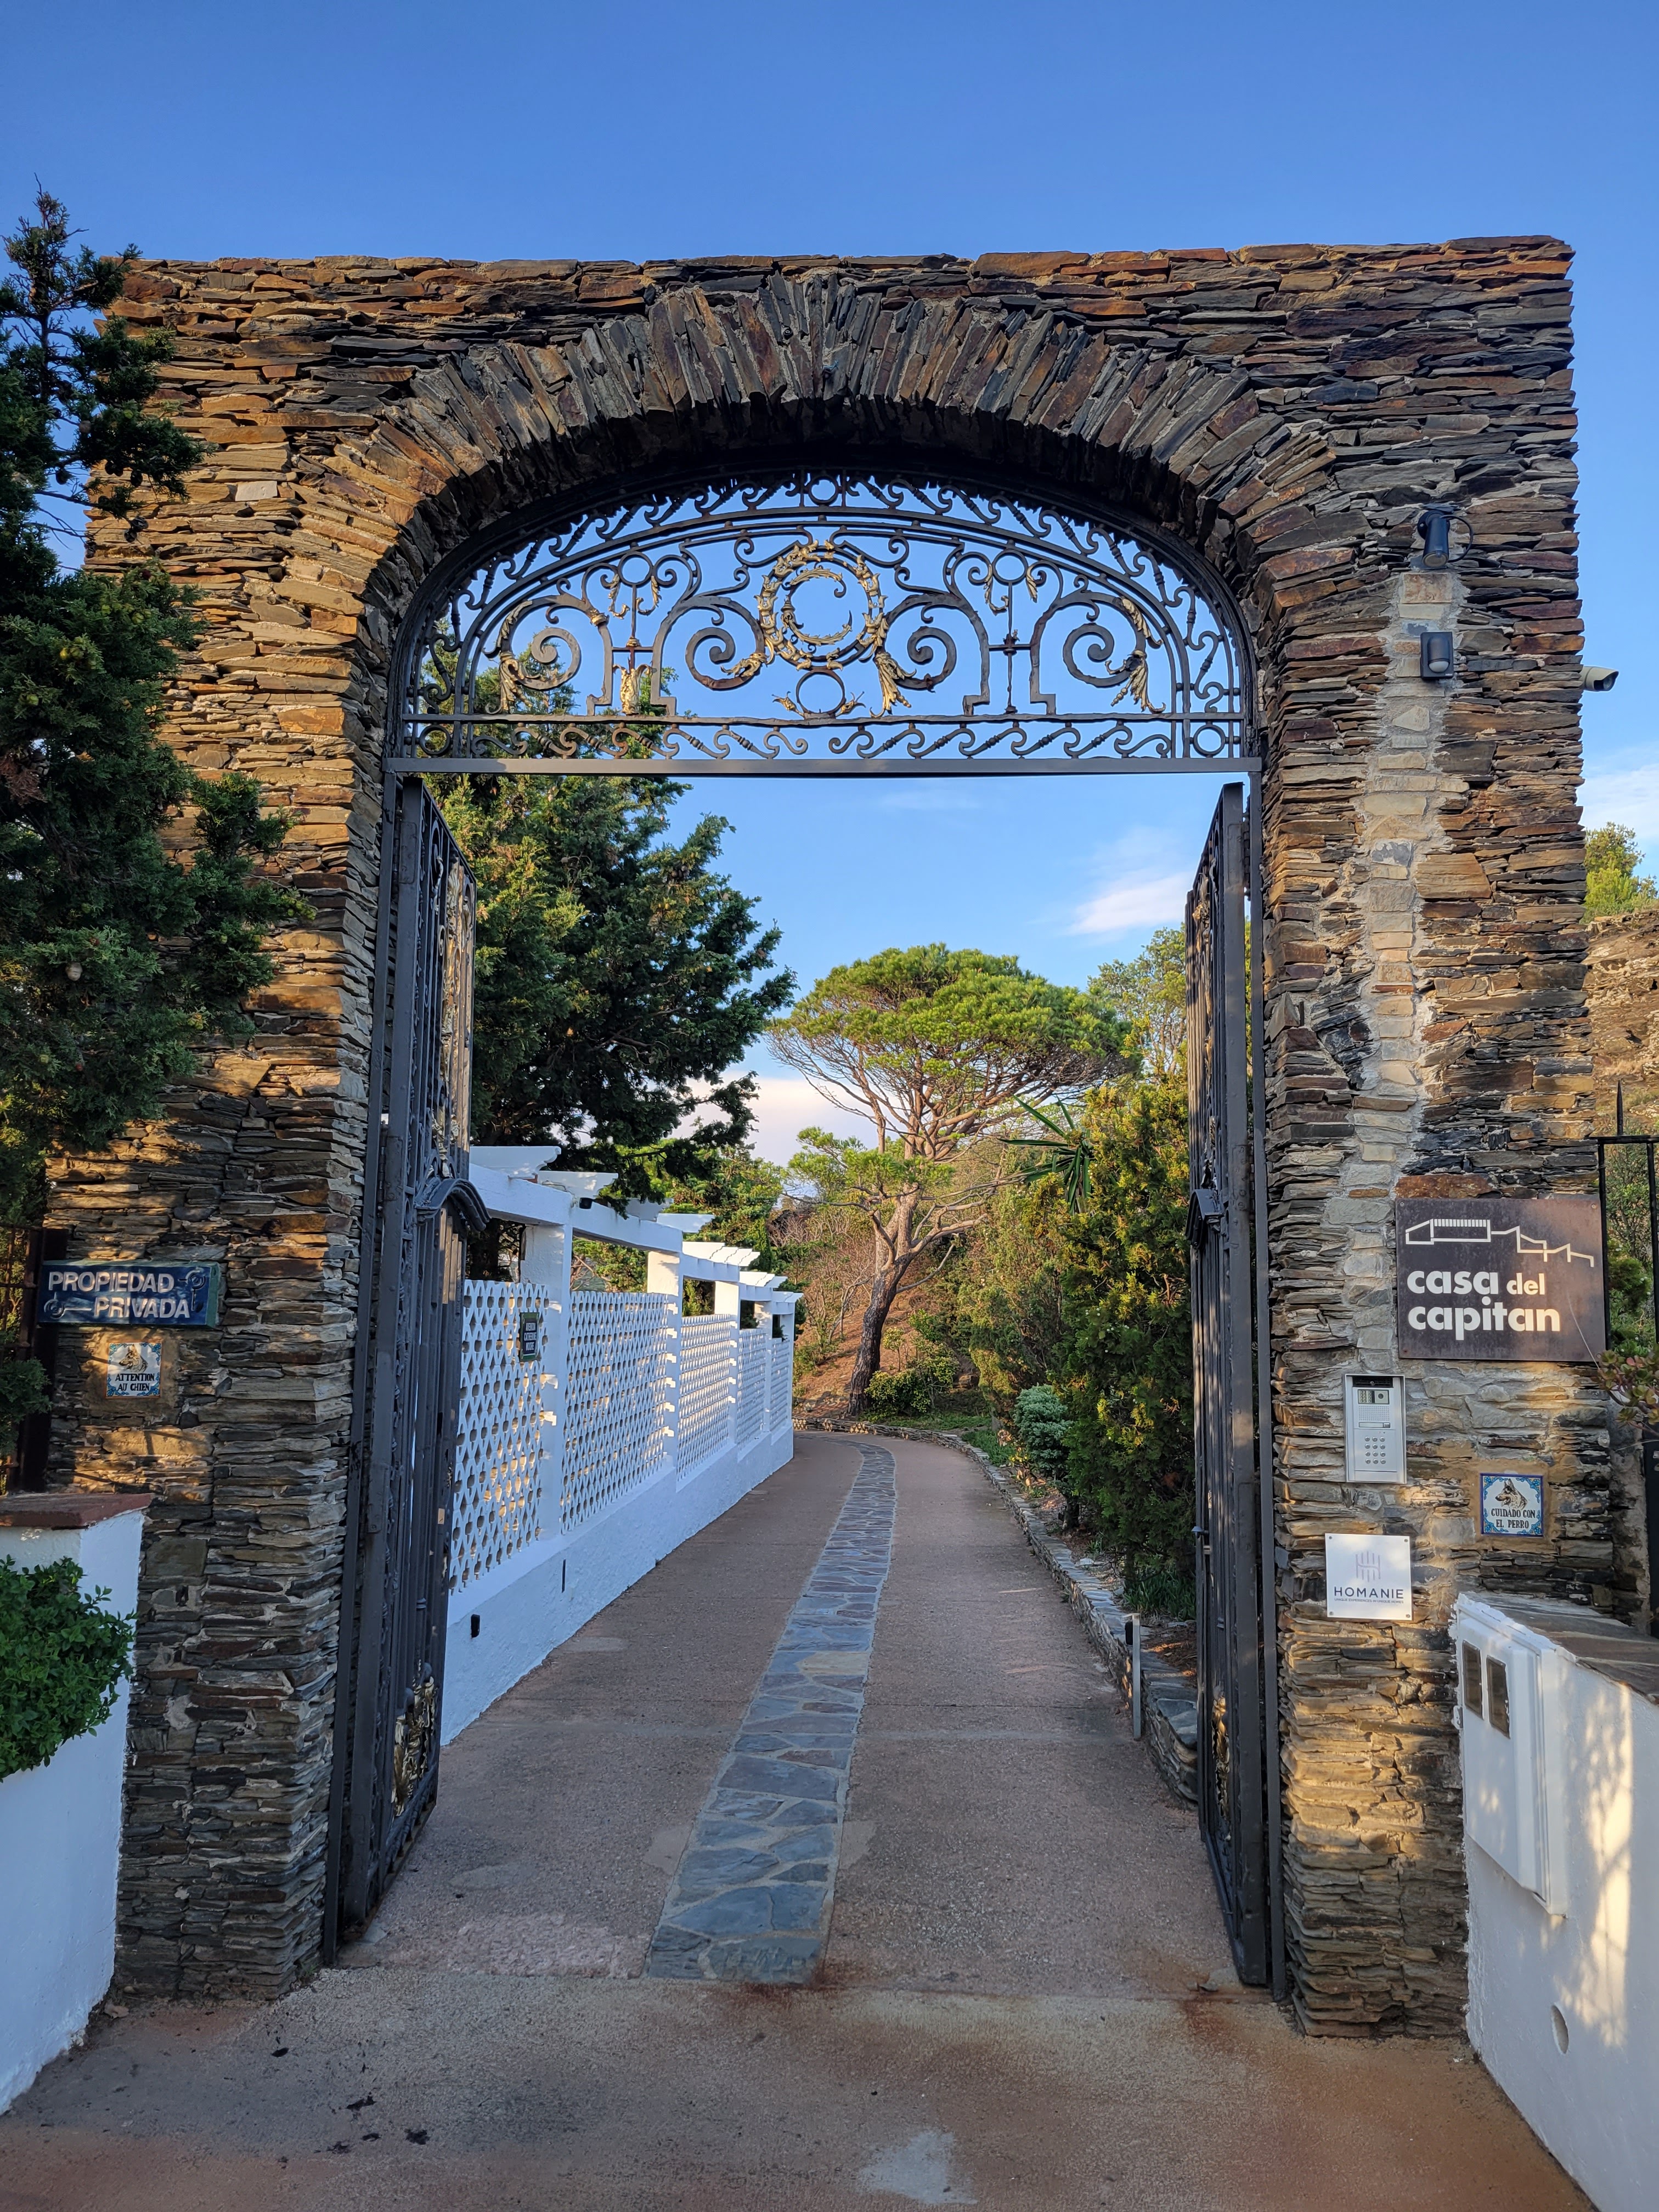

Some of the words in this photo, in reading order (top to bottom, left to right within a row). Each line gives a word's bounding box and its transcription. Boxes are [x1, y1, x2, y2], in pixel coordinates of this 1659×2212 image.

[48, 1271, 174, 1293] PROPIEDAD
[1407, 1270, 1498, 1295] casa
[1506, 1272, 1545, 1295] del
[94, 1297, 190, 1319] PRIVADA
[1408, 1296, 1560, 1341] capitan
[115, 1373, 155, 1381] ATTENTION
[1491, 1508, 1521, 1518] CUIDADO
[1522, 1509, 1536, 1519] CON
[1496, 1519, 1504, 1528] EL
[1507, 1519, 1529, 1529] PERRO
[1334, 1586, 1404, 1599] HOMANIE
